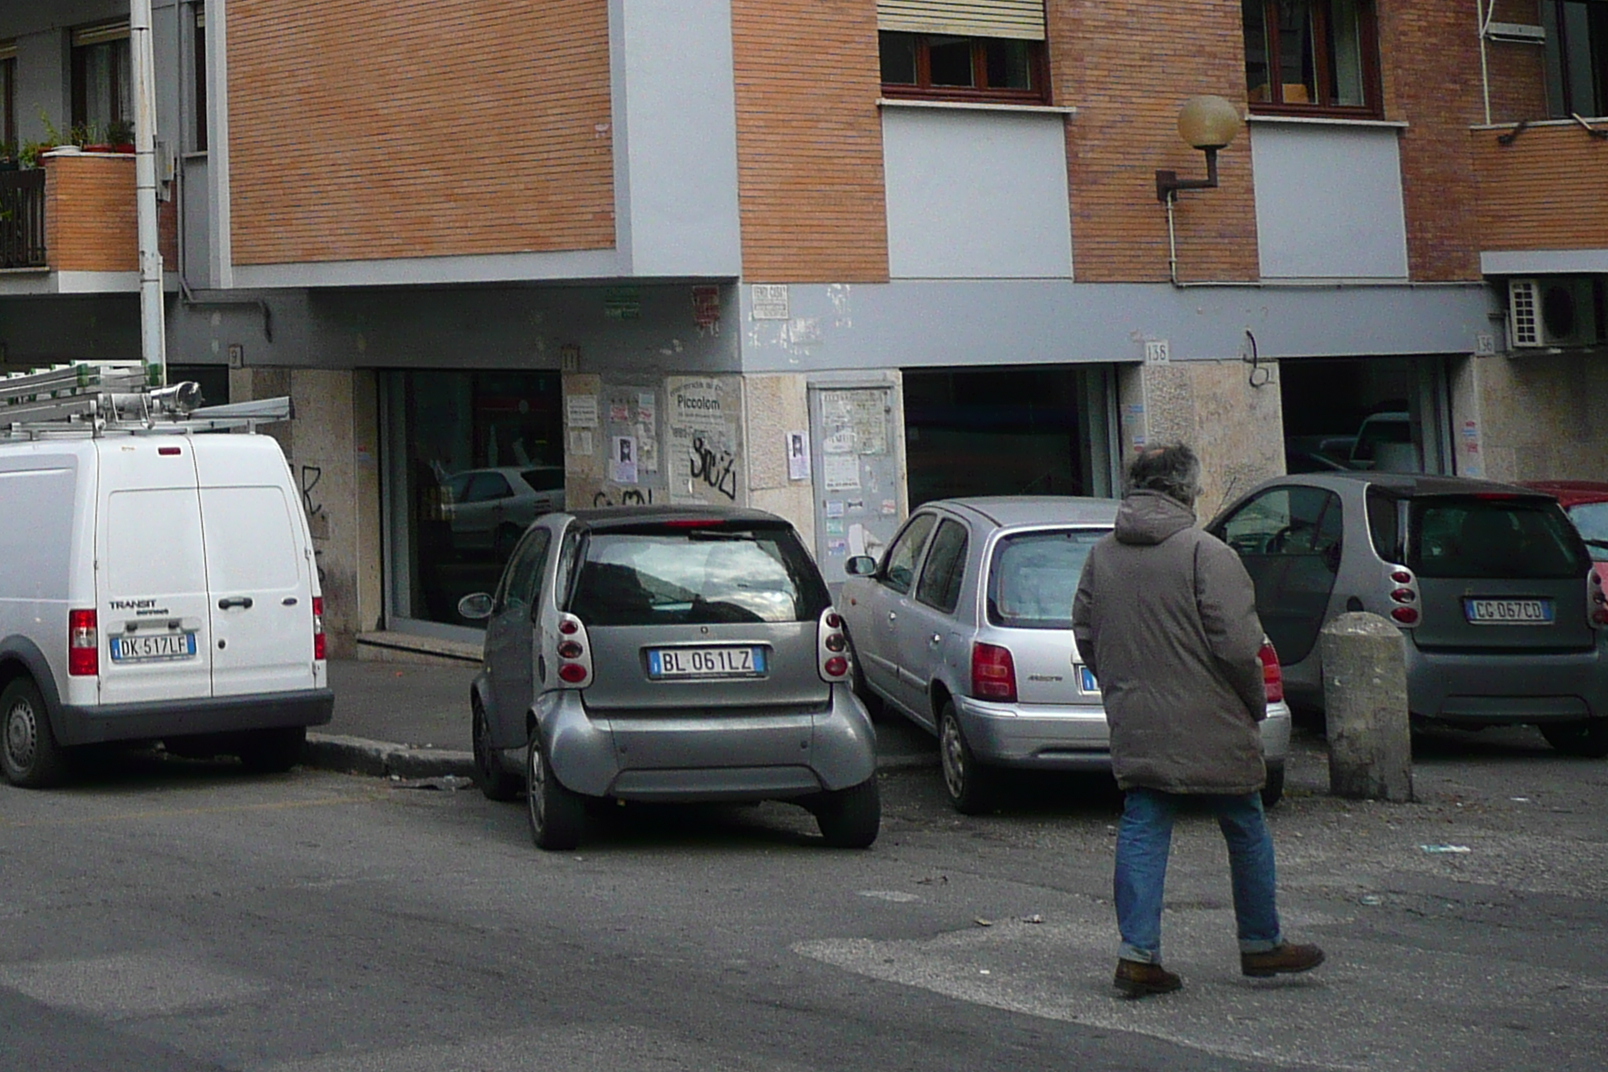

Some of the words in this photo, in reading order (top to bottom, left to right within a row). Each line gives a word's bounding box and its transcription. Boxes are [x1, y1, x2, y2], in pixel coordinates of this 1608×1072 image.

[1148, 344, 1167, 361] 138
[109, 600, 157, 610] TRANSIT
[144, 637, 186, 655] 517LF
[692, 650, 752, 671] 061LZ
